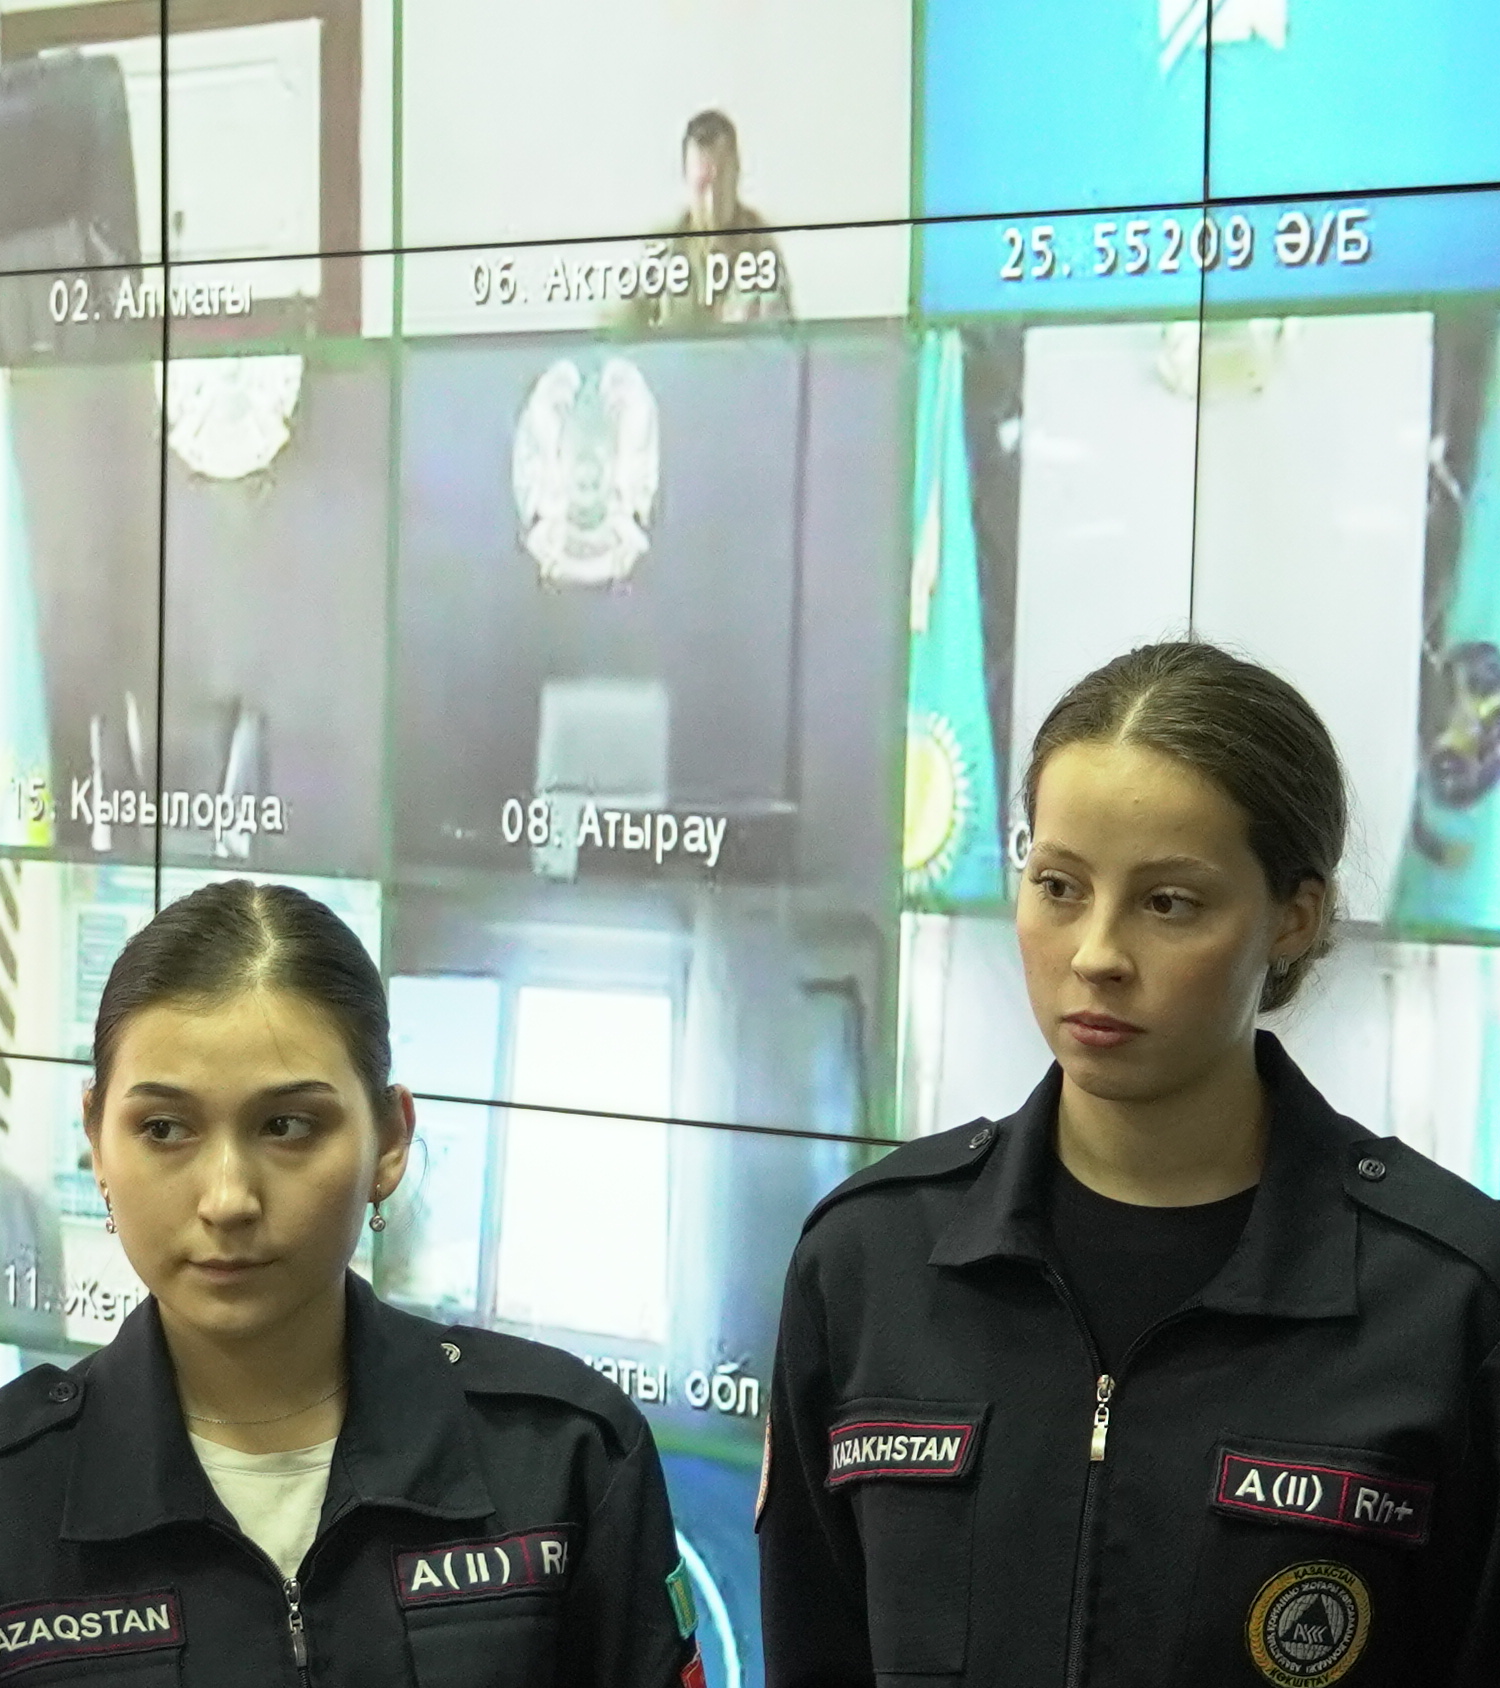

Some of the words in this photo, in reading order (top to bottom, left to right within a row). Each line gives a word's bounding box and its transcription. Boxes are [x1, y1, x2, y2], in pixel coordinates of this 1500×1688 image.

[1000, 225, 1072, 281] 25.
[1093, 214, 1255, 278] 55209
[50, 277, 101, 323] 02.
[113, 274, 252, 320] Алматы
[470, 256, 528, 305] 06.
[704, 249, 777, 306] рез
[12, 777, 57, 824] 15.
[501, 797, 563, 847] 08.
[576, 799, 728, 868] Атырау
[4, 1263, 52, 1311] 11.
[584, 1354, 669, 1404] аты
[684, 1361, 761, 1418] обл
[831, 1435, 961, 1471] KAZAKHSTAN
[1354, 1486, 1414, 1525] Rh+
